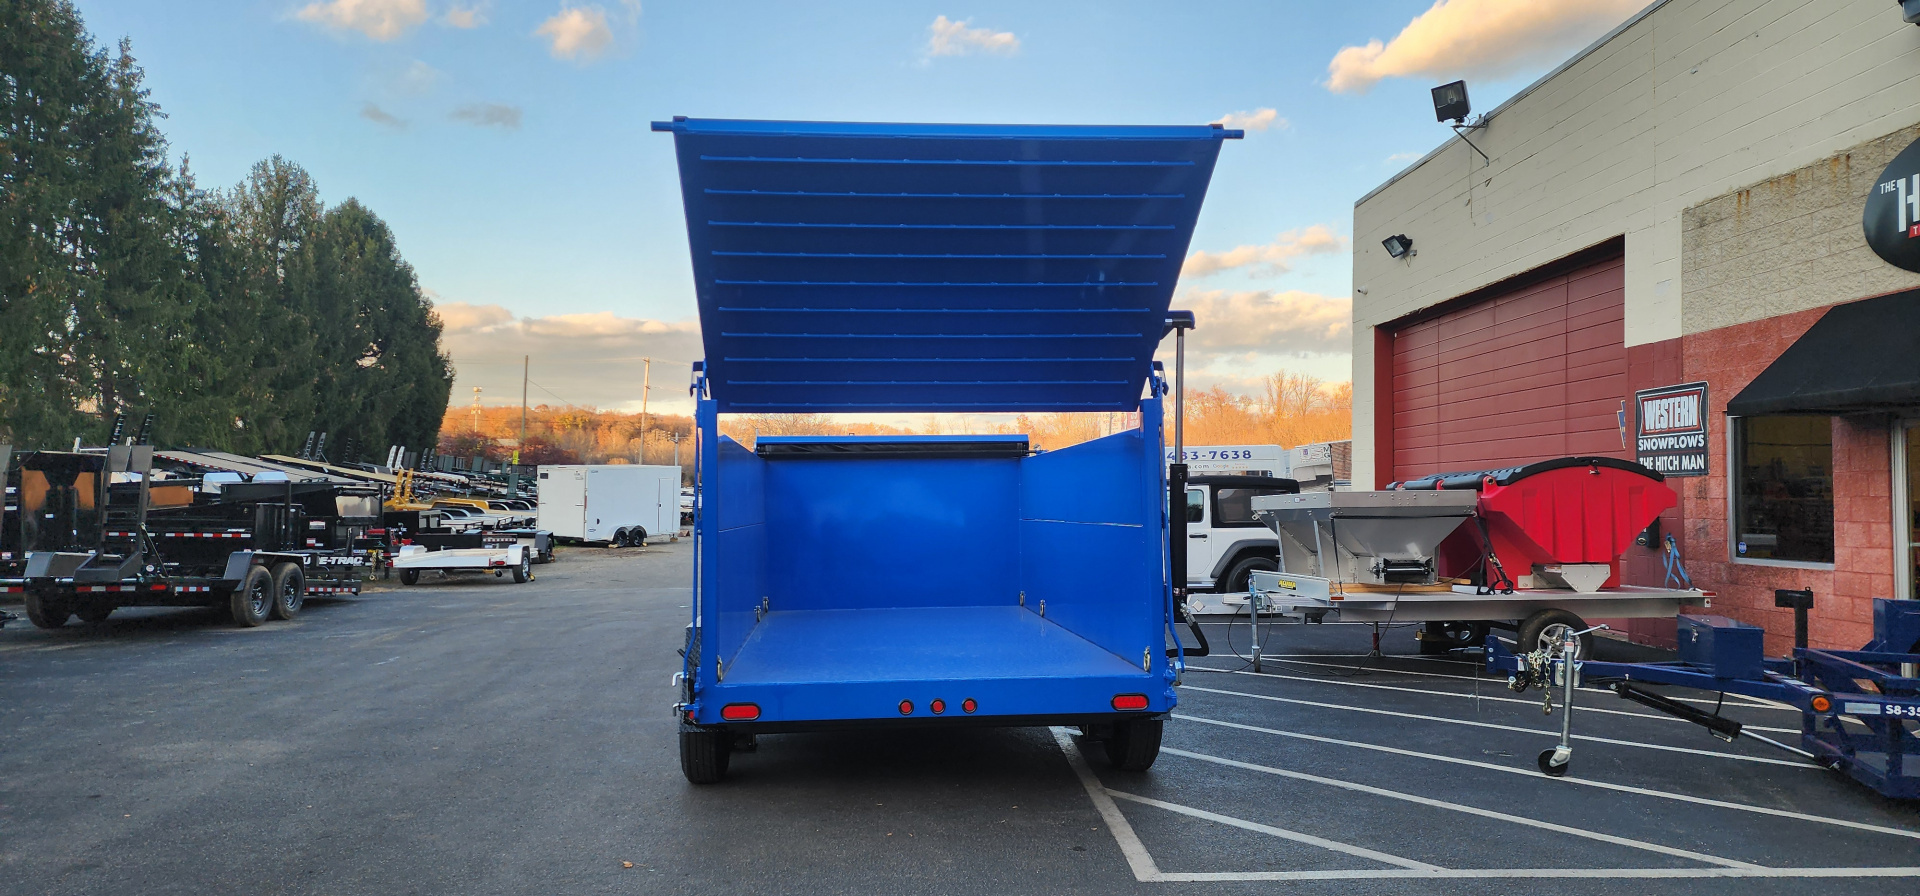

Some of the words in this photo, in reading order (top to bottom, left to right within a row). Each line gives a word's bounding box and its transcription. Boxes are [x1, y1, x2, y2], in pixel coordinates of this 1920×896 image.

[1880, 180, 1896, 195] THE
[1644, 394, 1698, 431] WESTERN
[1638, 434, 1705, 451] SNOWPLOWS
[1639, 456, 1653, 470] THE
[1655, 455, 1680, 471] HITCH
[1681, 454, 1705, 470] MAN
